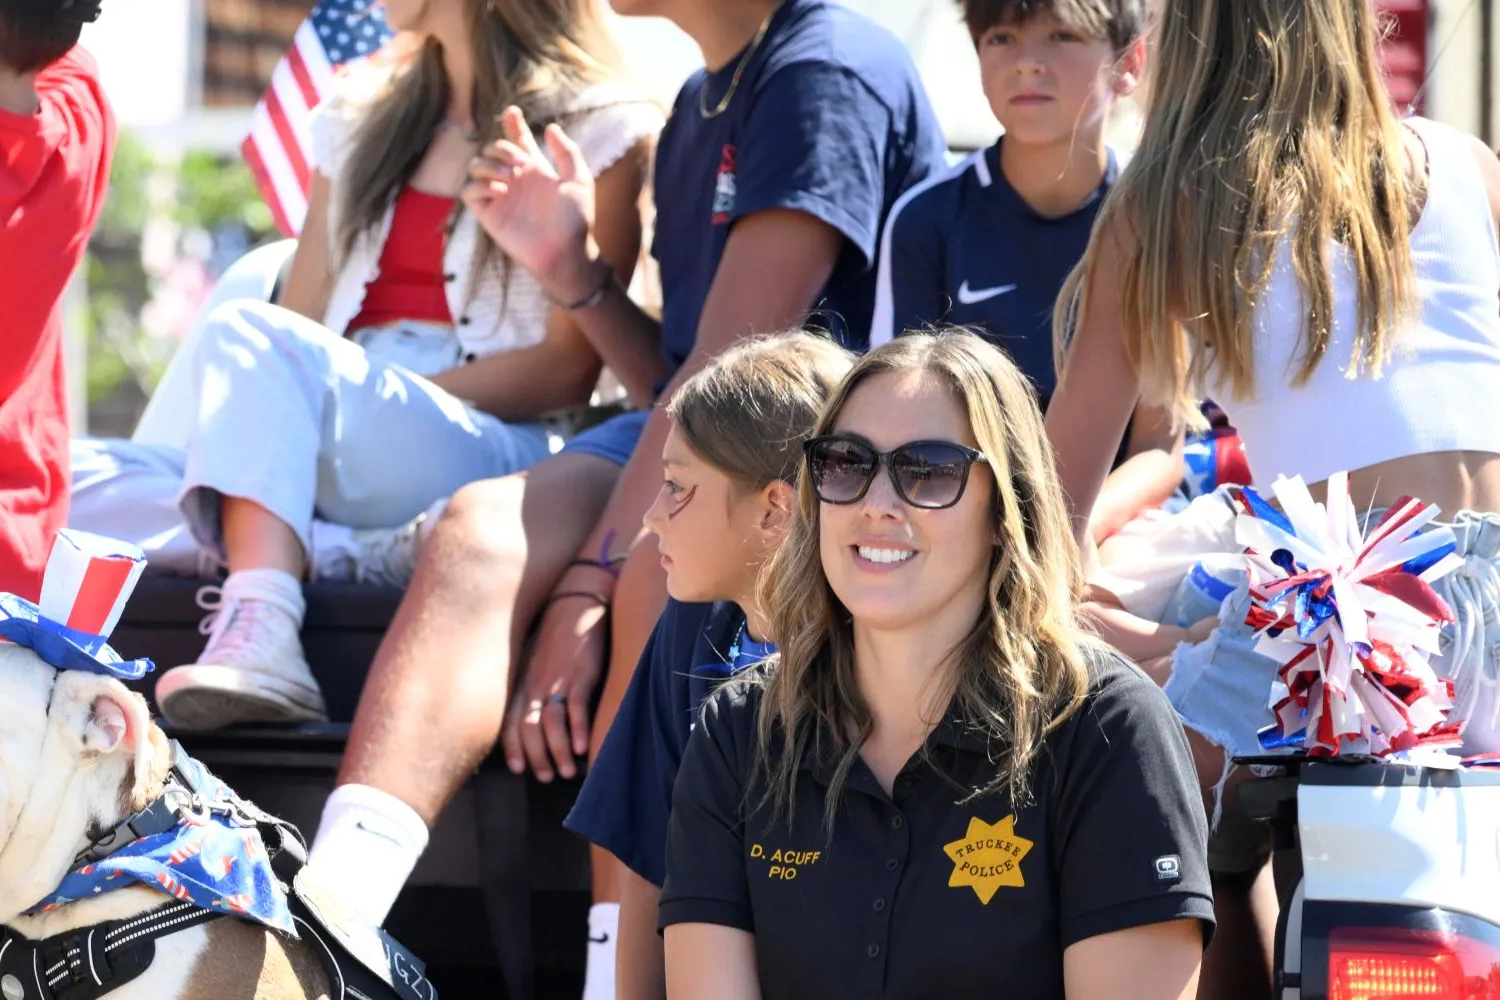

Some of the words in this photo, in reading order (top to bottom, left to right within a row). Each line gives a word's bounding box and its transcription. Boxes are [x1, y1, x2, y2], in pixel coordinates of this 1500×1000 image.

[750, 843, 766, 860] D.
[770, 848, 821, 865] ACUFF
[956, 839, 1021, 858] TRUCKEE
[768, 866, 797, 880] PIO
[960, 859, 1014, 877] POLICE
